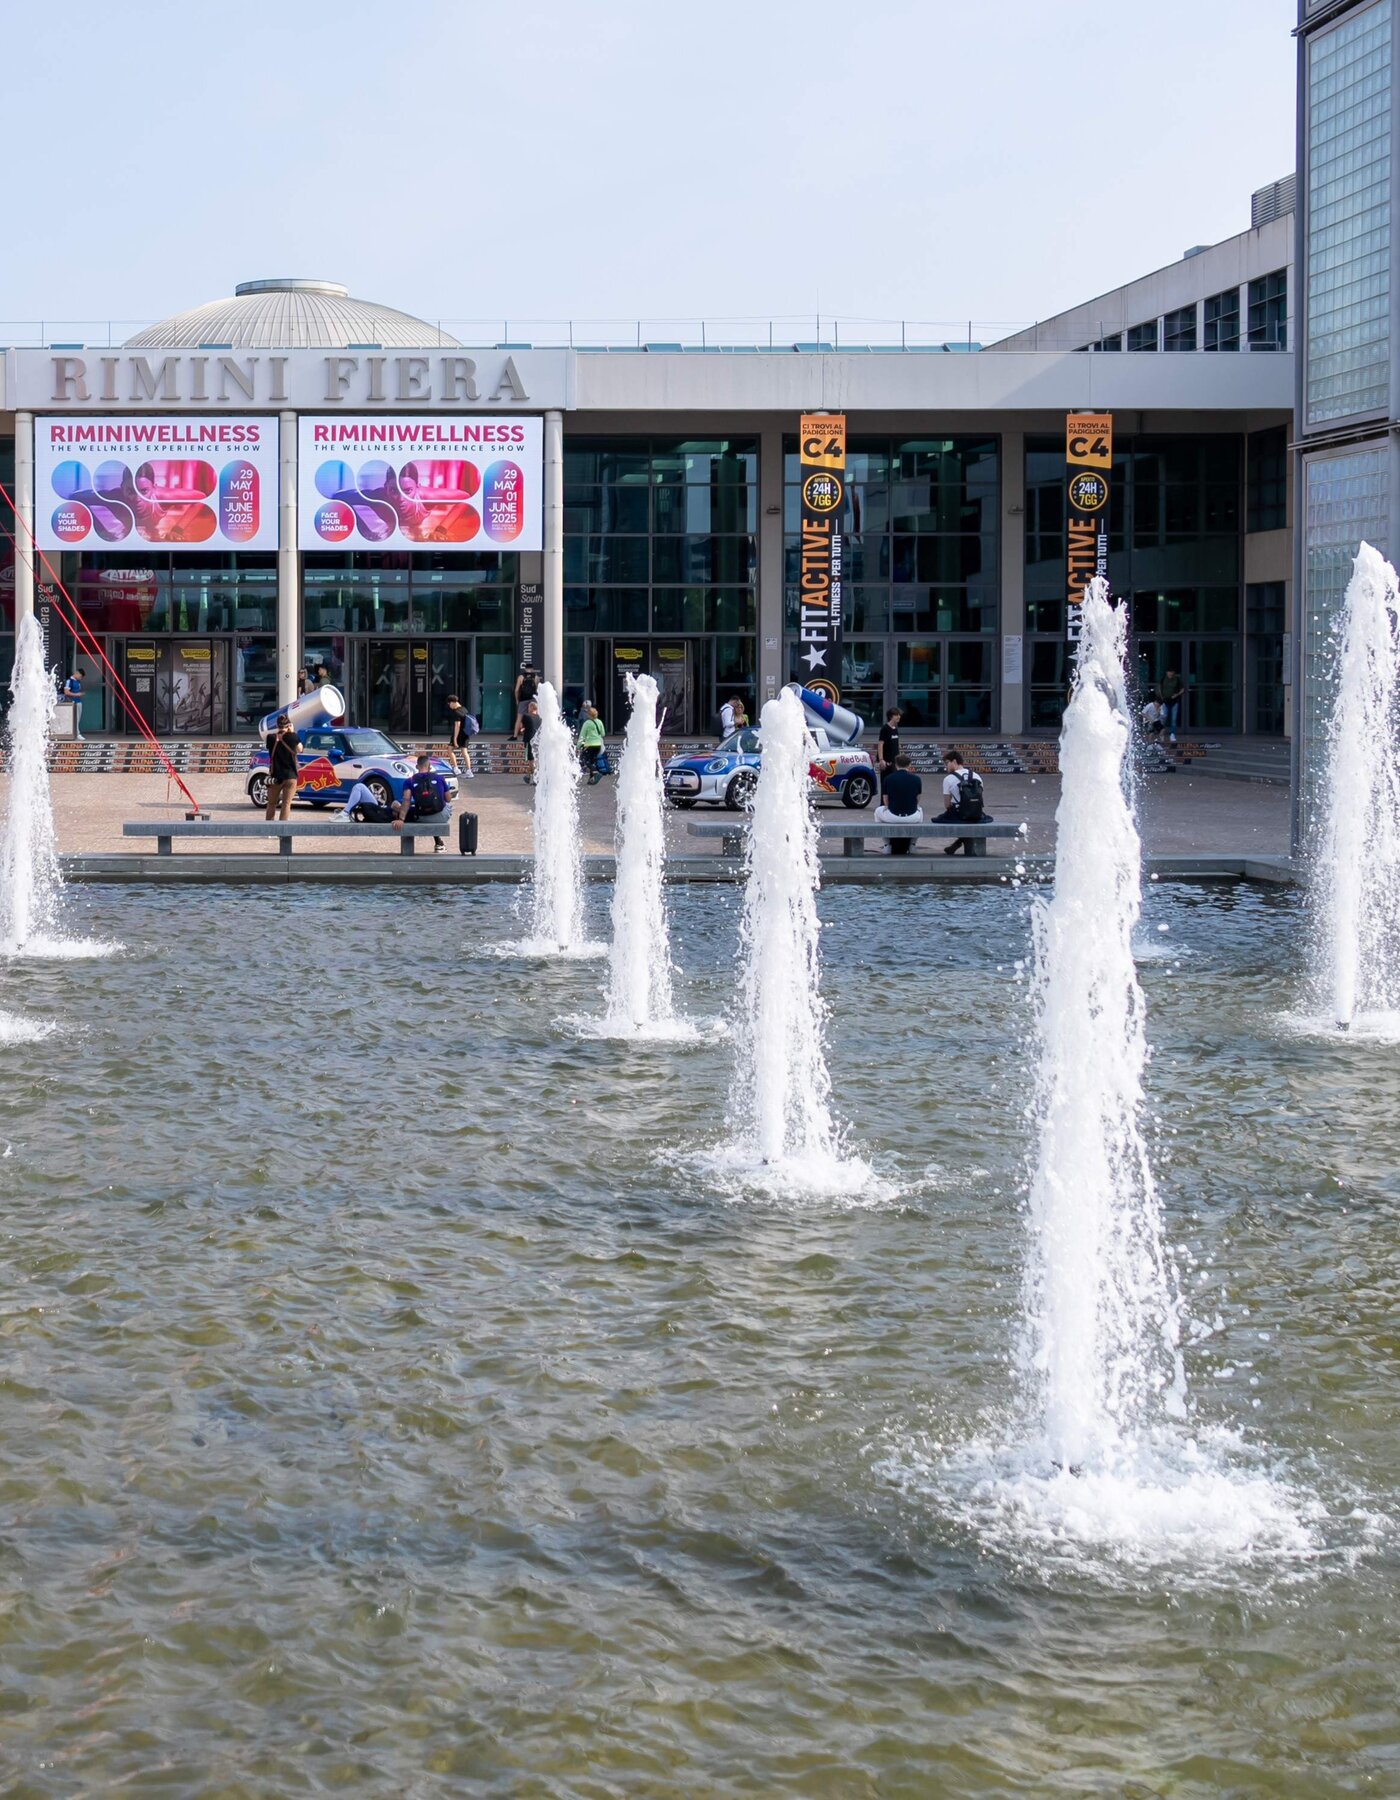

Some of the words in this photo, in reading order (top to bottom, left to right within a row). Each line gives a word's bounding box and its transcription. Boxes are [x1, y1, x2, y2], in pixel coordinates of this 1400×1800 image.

[51, 357, 289, 401] RIMINI
[323, 355, 531, 401] FIERA
[51, 425, 260, 442] RIMINIWELLNESS
[314, 425, 524, 442] RIMINIWELLNESS
[803, 438, 843, 458] C4
[1069, 437, 1109, 457] C4
[240, 469, 253, 479] 29
[504, 469, 516, 479] 29
[230, 480, 252, 490] MAY
[494, 480, 516, 490] MAY
[812, 483, 831, 495] 24H
[1078, 482, 1097, 494] 24H
[242, 492, 253, 500] 01
[506, 492, 516, 500] 01
[813, 495, 831, 506] 7GG
[1079, 494, 1097, 505] 7GG
[225, 502, 253, 512] JUNE
[488, 502, 516, 512] JUNE
[228, 513, 253, 523] 2025
[492, 513, 516, 523] 2025
[831, 534, 841, 558] TUTTI
[1097, 534, 1107, 557] TUTTI
[831, 559, 841, 576] PER
[800, 519, 830, 642] FITACTIVE
[37, 584, 54, 593] Sud
[520, 584, 537, 593] Sud
[520, 594, 543, 603] South
[831, 581, 841, 616] FITNESS
[520, 607, 532, 633] Fiera
[831, 616, 841, 626] IL
[840, 755, 854, 764] Red
